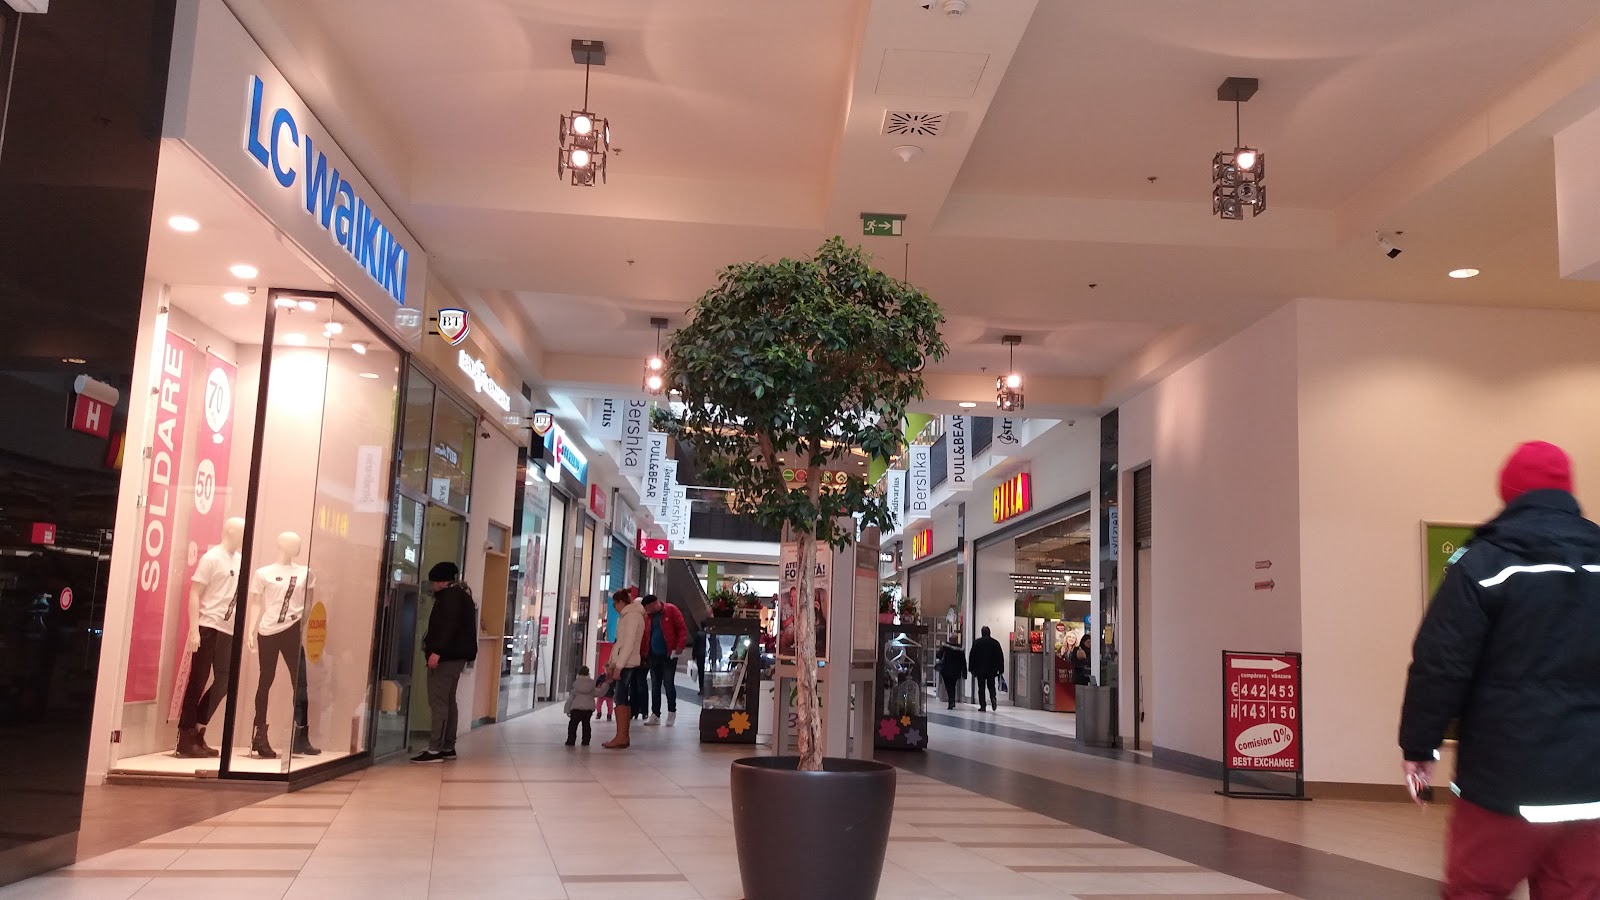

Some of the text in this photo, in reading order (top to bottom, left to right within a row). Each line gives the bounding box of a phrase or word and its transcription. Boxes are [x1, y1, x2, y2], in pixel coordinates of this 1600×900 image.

[243, 75, 304, 188] LC
[443, 316, 461, 328] BT
[86, 400, 101, 431] H
[208, 380, 223, 413] 70
[140, 343, 184, 593] SOLDARE
[952, 414, 966, 483] PULL&BEAR
[196, 472, 213, 501] 50
[646, 440, 661, 498] PULL&BEAR
[913, 452, 926, 511] Bershka
[670, 490, 684, 536] Bershka
[993, 472, 1024, 523] BILLA
[913, 529, 928, 561] BILLA
[1238, 728, 1291, 751] comision 0%
[1232, 757, 1294, 768] BEST EXCHANGE
